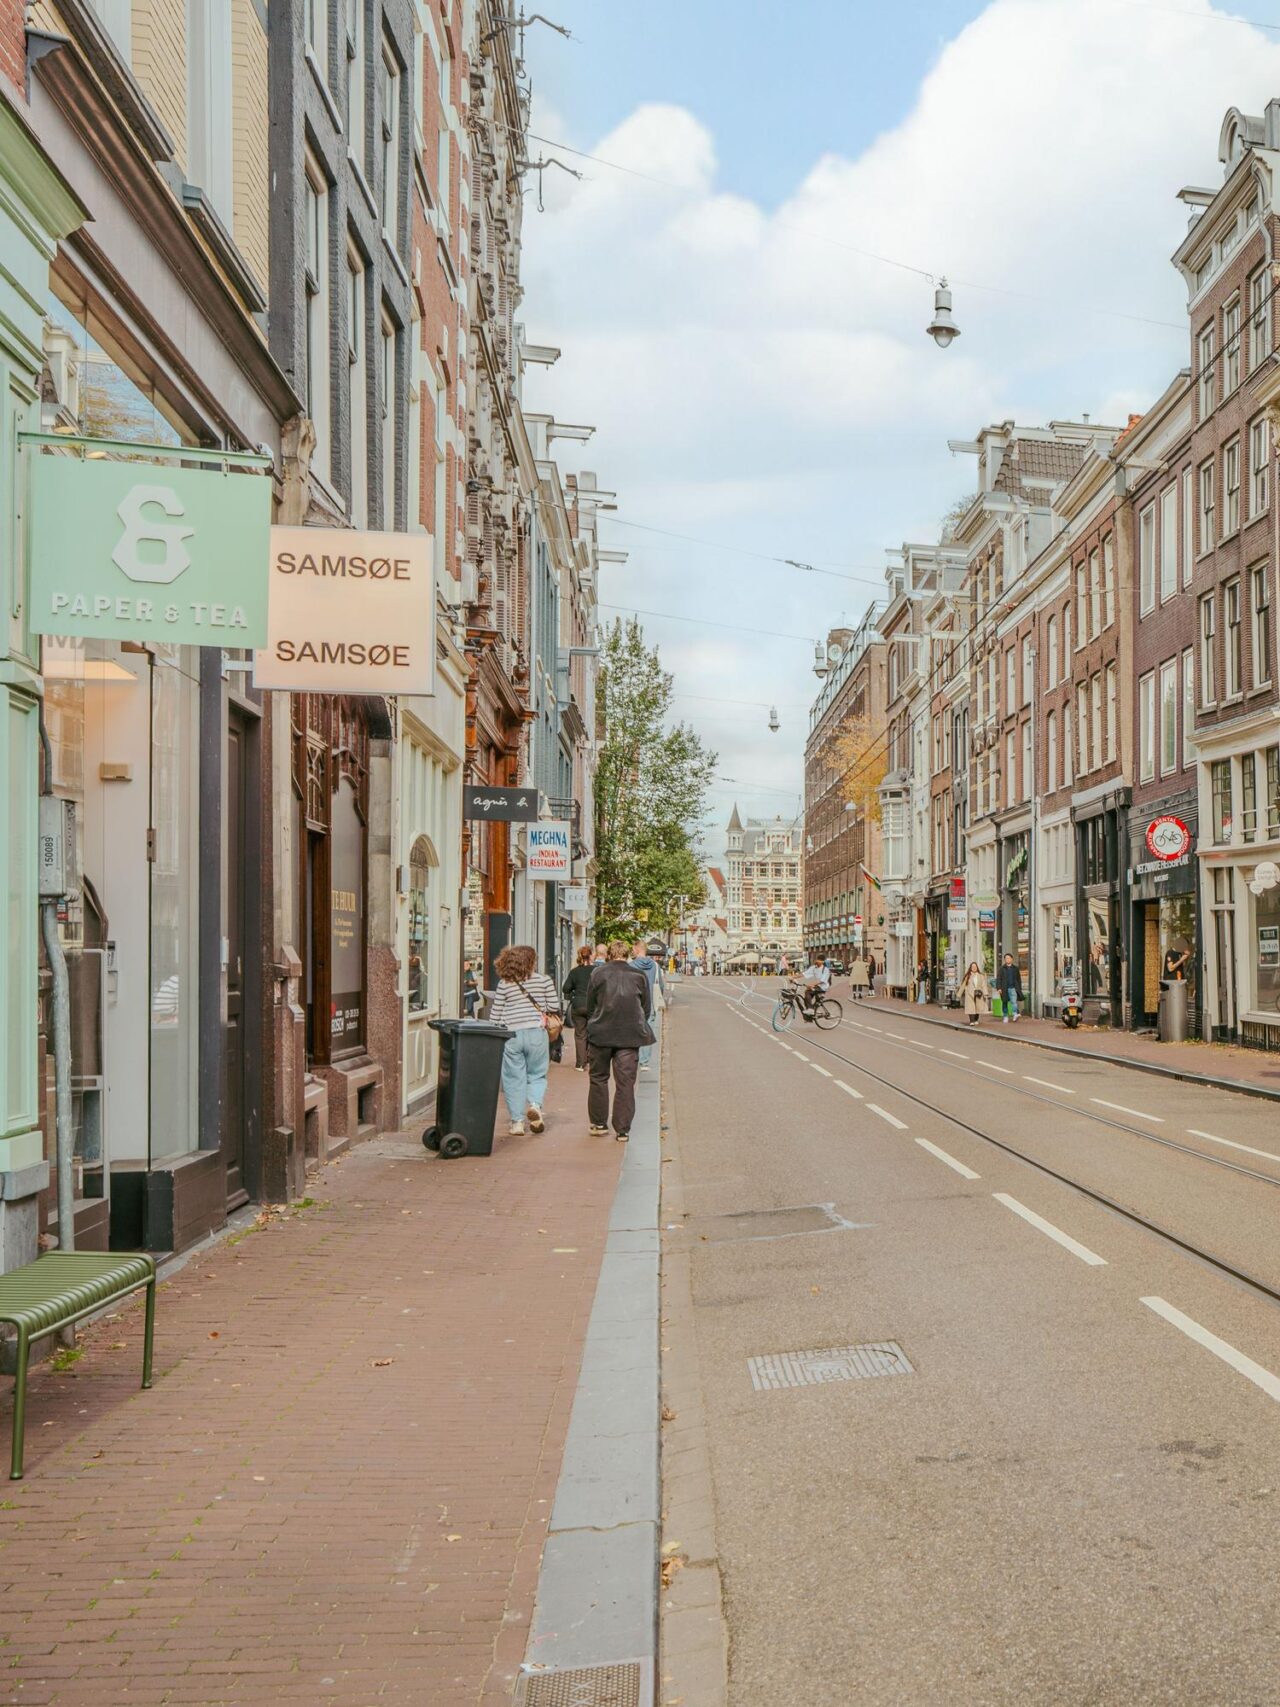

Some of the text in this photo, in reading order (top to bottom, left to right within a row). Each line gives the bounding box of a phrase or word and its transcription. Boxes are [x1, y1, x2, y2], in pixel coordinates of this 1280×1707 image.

[276, 552, 411, 581] SAMSØE
[51, 593, 248, 629] PAPER & TEA
[275, 640, 410, 667] SAMSØE
[1154, 817, 1176, 825] RENTAL
[530, 830, 567, 848] MEGHNA
[44, 837, 54, 868] 150089
[530, 859, 567, 868] RESTAURANT
[539, 850, 559, 858] INDIAN
